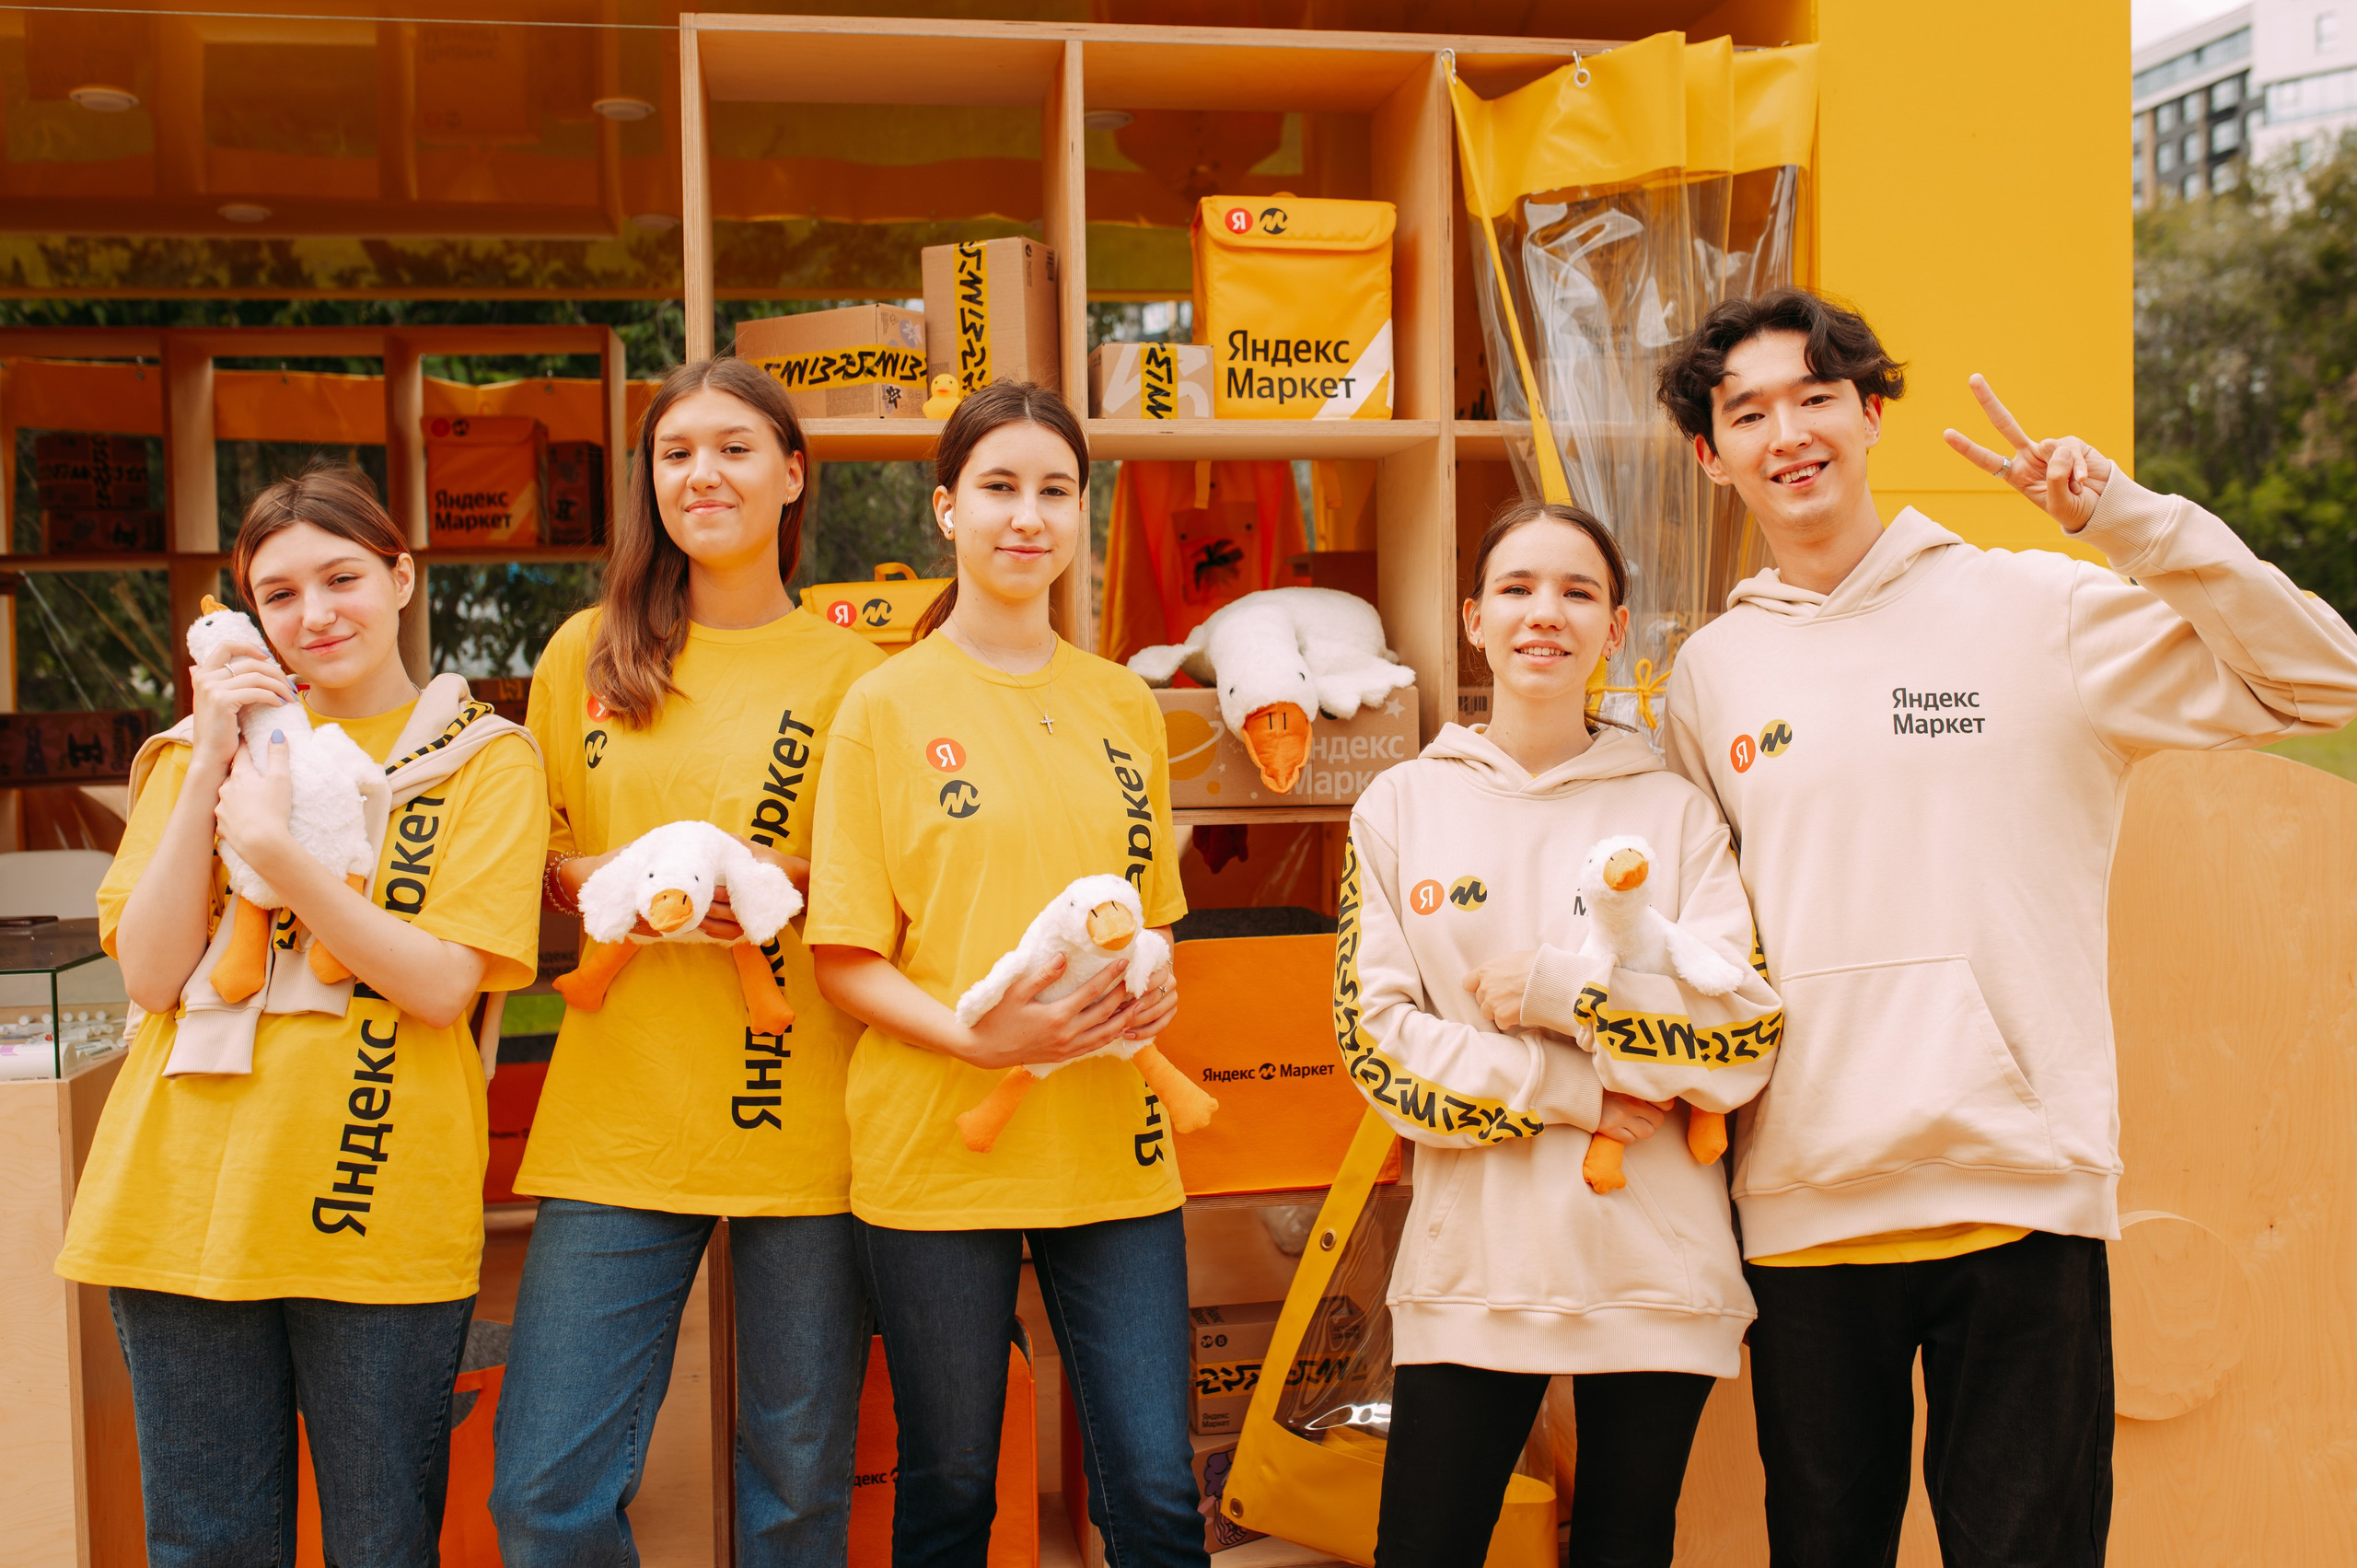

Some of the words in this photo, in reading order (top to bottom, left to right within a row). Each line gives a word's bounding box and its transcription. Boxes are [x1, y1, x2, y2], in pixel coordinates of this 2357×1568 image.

[1227, 330, 1350, 367] Яндекс
[1226, 367, 1356, 405] Маркет
[435, 489, 509, 510] Яндекс
[435, 511, 513, 532] Маркет
[1892, 687, 1980, 711] Яндекс
[1892, 713, 1986, 738] Маркет
[1310, 735, 1405, 764] ндекс
[749, 709, 815, 848] ркет
[1285, 764, 1384, 800] Марк
[1202, 1068, 1256, 1083] Яндекс
[1280, 1063, 1335, 1079] Маркет
[312, 1018, 399, 1237] Яндекс
[1202, 1412, 1230, 1421] Яндекс
[1202, 1419, 1230, 1428] Маркет
[853, 1473, 888, 1488] декс
